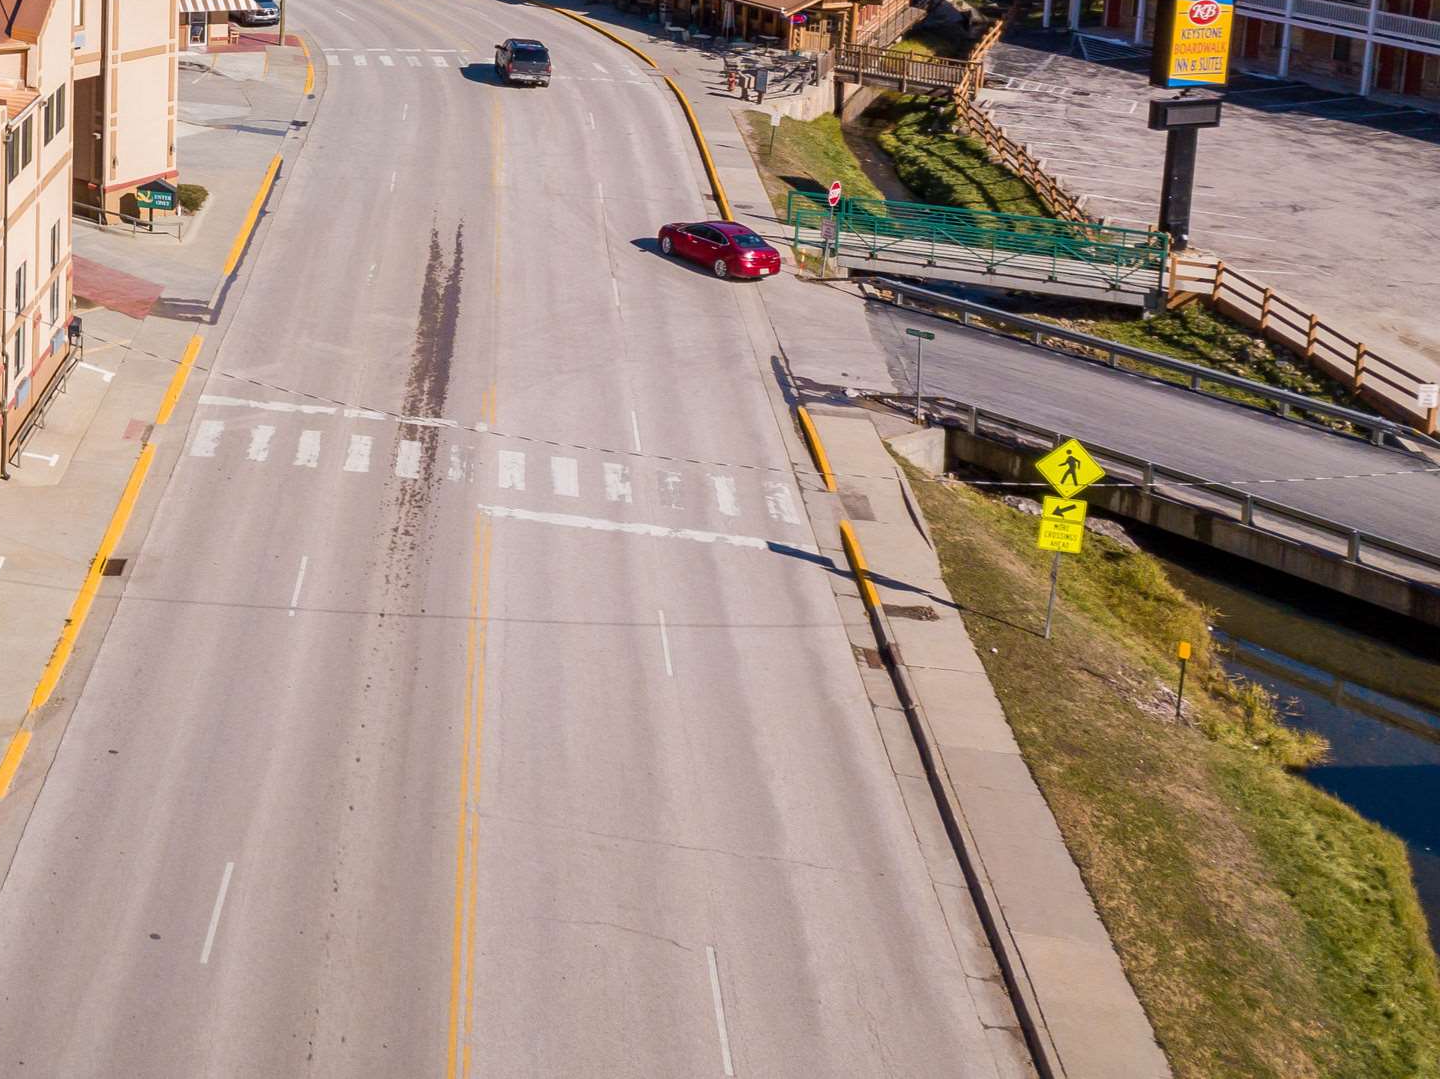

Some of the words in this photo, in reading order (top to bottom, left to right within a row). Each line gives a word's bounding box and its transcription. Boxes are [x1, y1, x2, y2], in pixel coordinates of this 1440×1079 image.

[1192, 2, 1217, 21] KB
[1181, 27, 1223, 41] KEYSTONE
[1173, 41, 1227, 56] BOARDWALK
[1174, 57, 1189, 74] INN
[1198, 55, 1223, 72] SUITES
